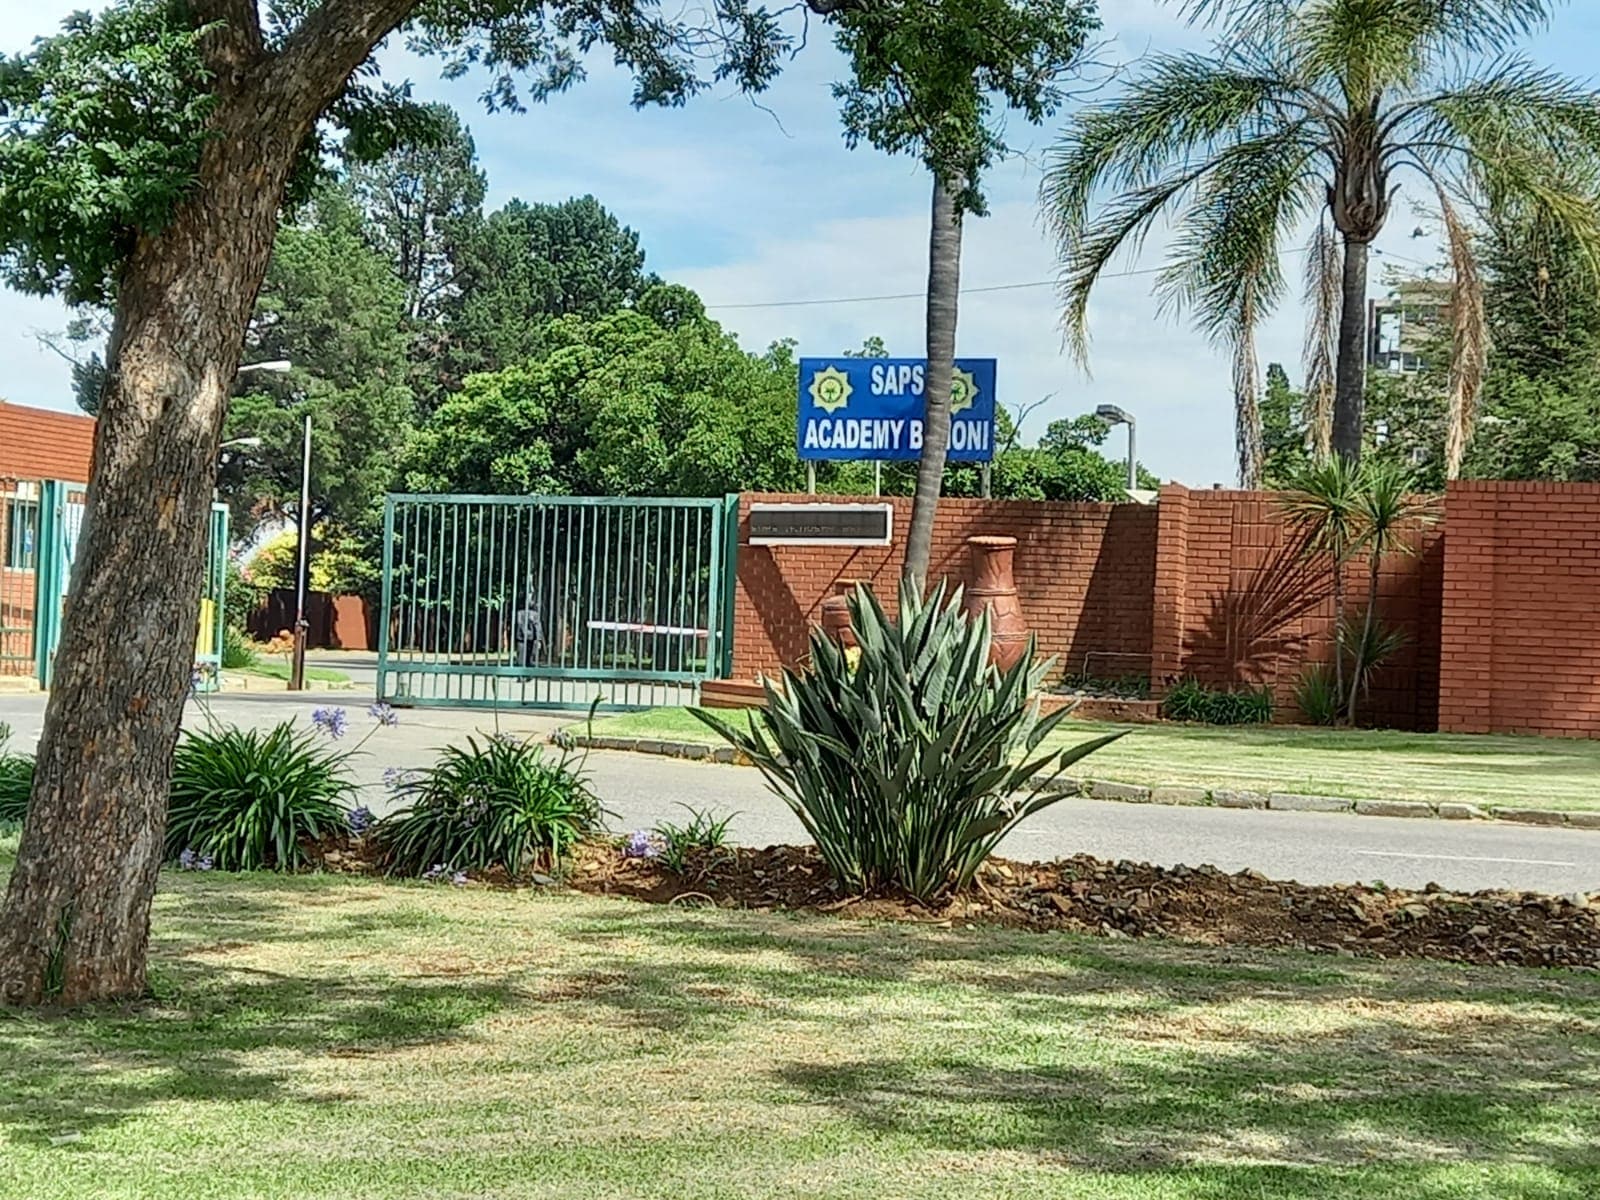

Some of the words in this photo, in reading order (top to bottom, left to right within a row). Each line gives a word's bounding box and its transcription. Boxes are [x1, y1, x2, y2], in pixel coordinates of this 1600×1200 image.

[871, 364, 925, 395] SAPS
[804, 419, 904, 450] ACADEMY
[909, 419, 989, 451] BONI
